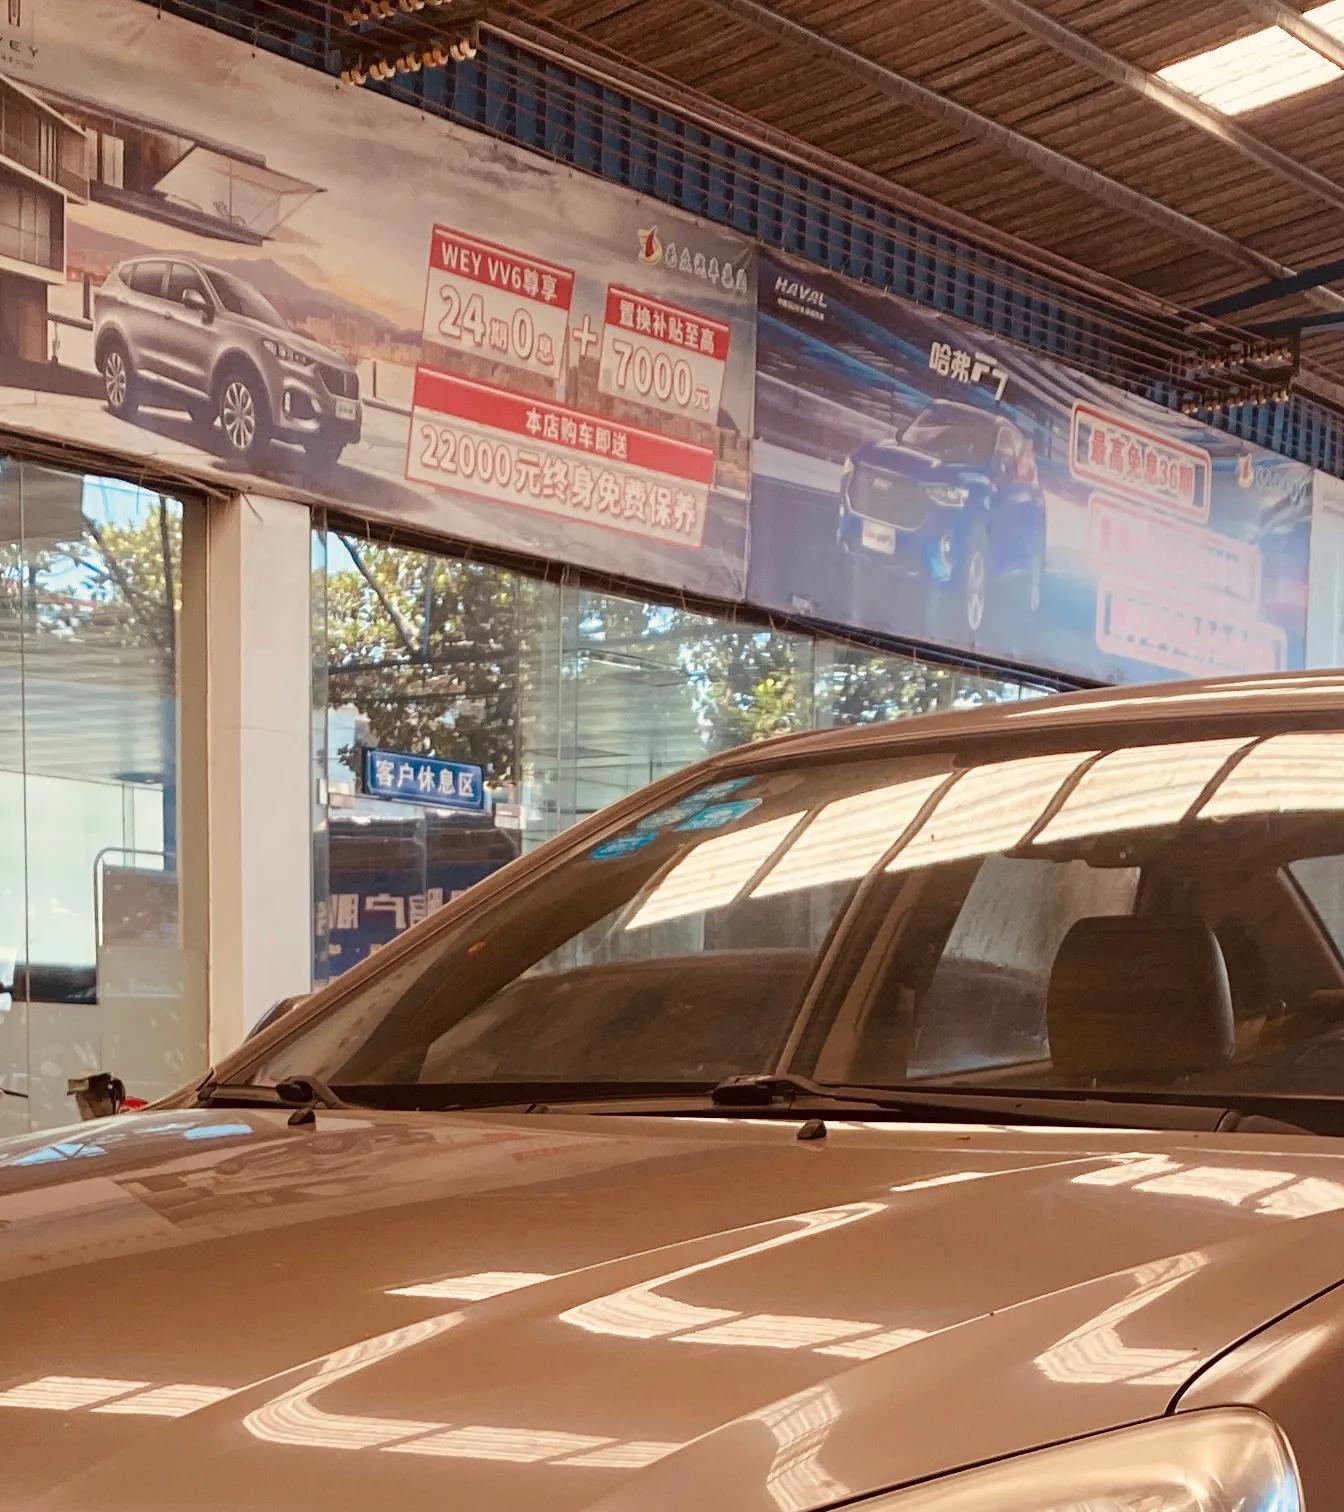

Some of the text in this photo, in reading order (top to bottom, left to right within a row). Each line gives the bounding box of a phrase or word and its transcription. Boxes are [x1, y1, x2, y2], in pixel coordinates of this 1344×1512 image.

[441, 241, 482, 276] WEY
[774, 276, 828, 308] HAVAL
[619, 299, 715, 355] 置换补贴至高
[613, 337, 711, 410] 7000元
[525, 407, 628, 459] 本店购车即送
[419, 424, 698, 534] 22000元终身免费保养
[1090, 428, 1194, 498] 最高免息36期
[374, 758, 475, 799] 客户休息区
